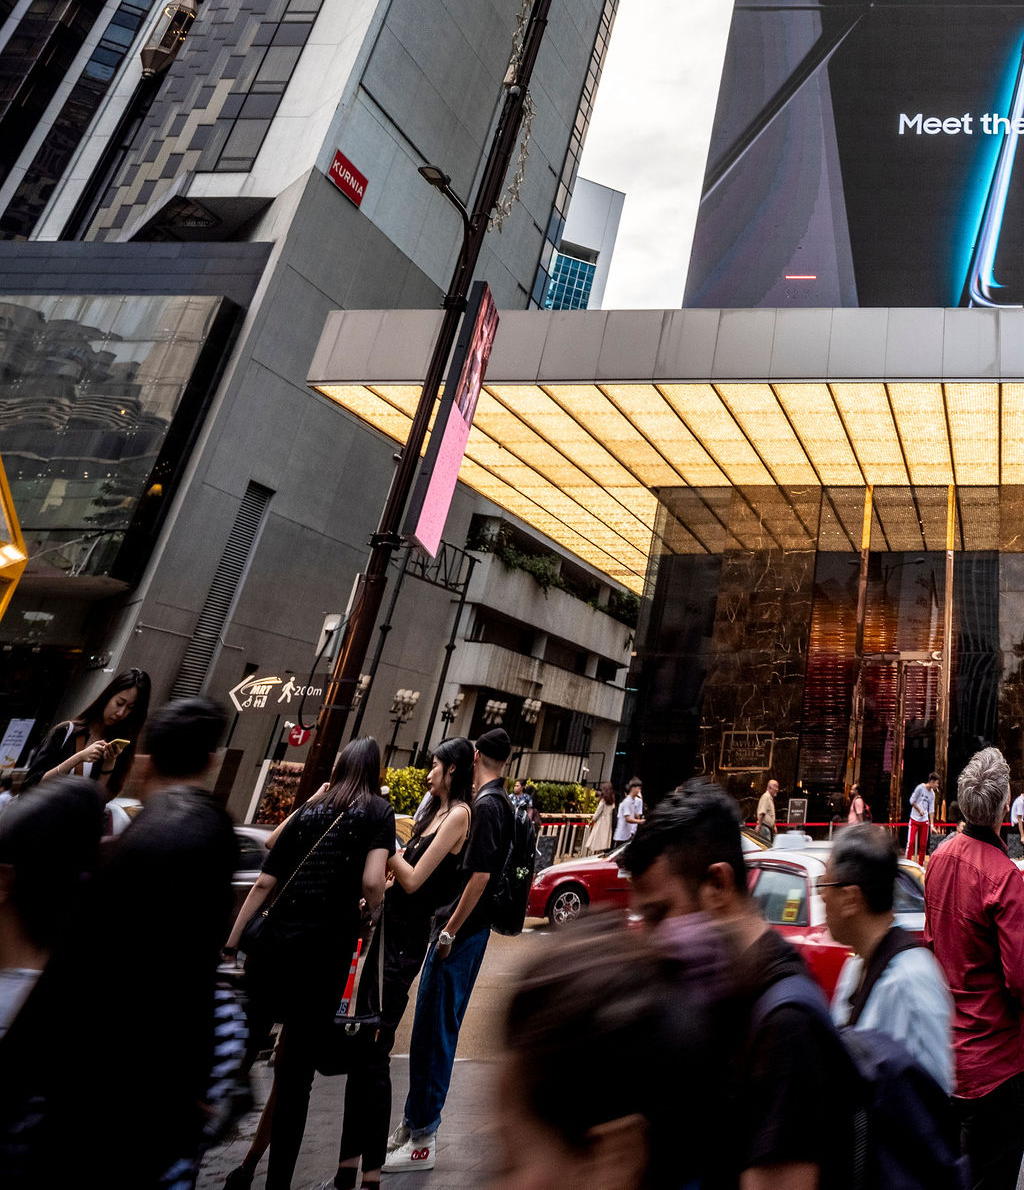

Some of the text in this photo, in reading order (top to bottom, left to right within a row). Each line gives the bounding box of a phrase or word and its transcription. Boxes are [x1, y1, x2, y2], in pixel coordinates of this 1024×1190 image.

[898, 113, 973, 135] Meet
[332, 159, 363, 197] KURNIA
[249, 685, 273, 695] MRT
